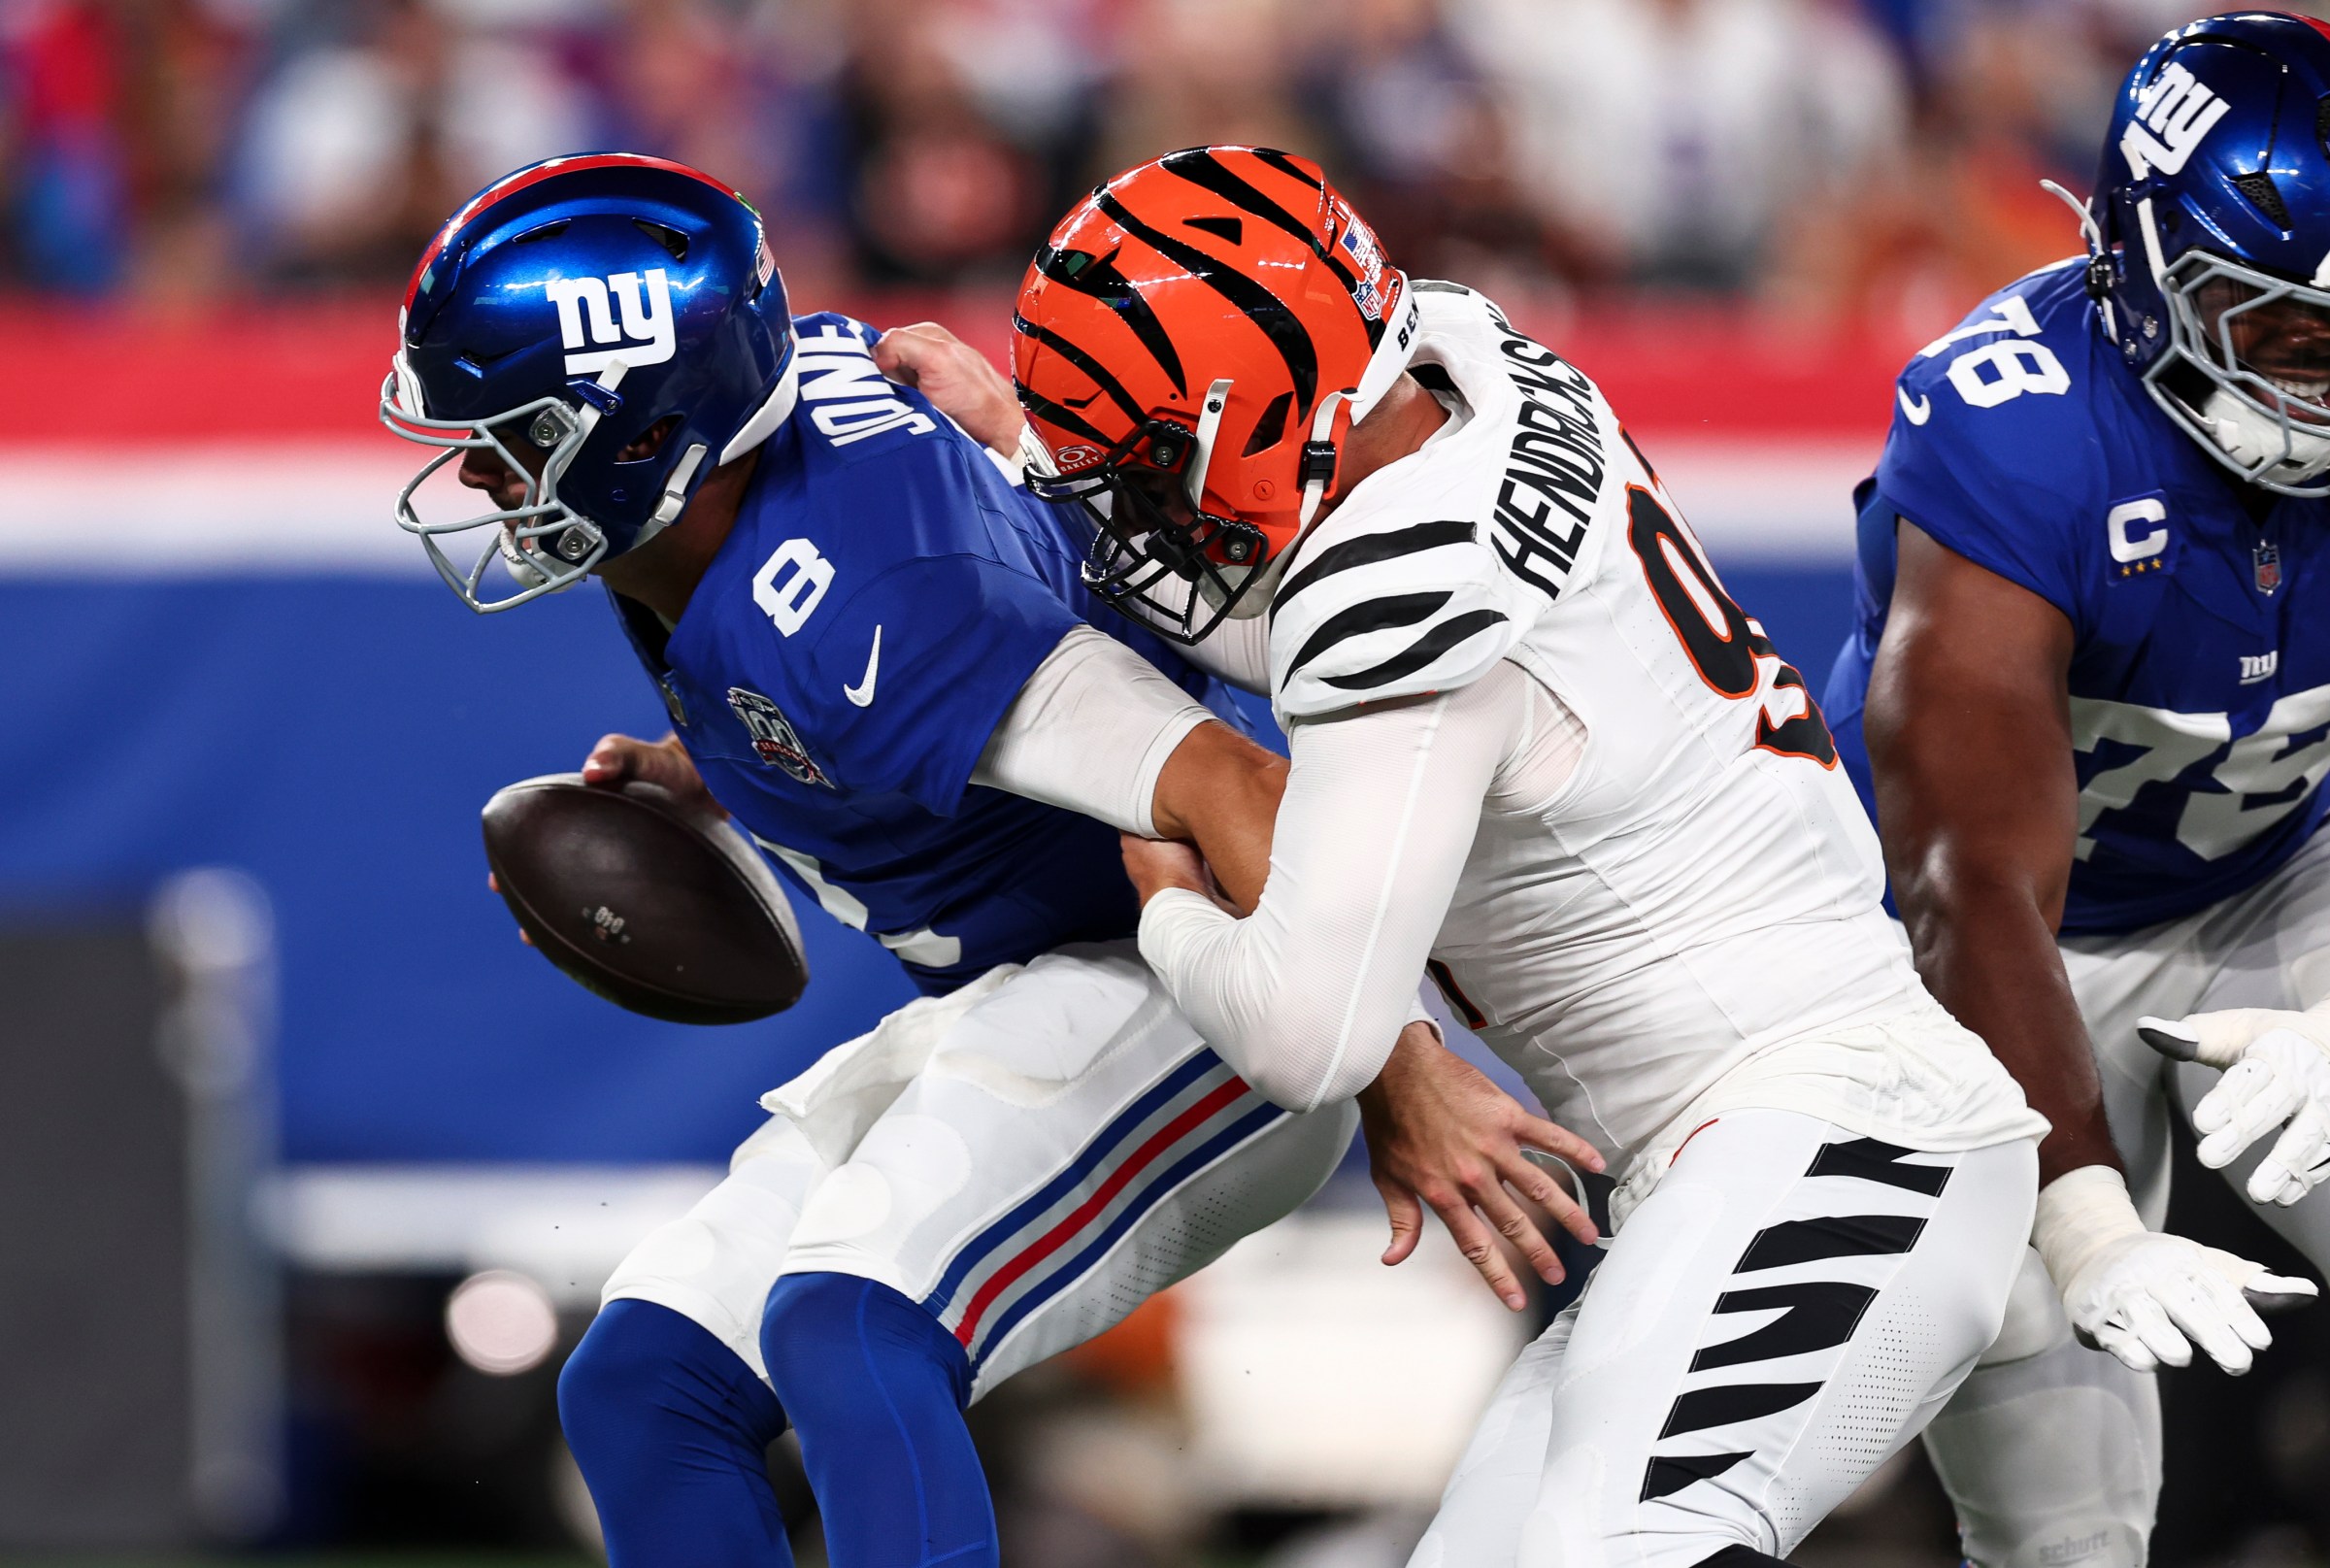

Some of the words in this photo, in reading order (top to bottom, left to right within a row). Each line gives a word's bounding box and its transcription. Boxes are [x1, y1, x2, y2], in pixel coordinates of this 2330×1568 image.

[1919, 295, 2071, 409] 78
[1060, 455, 1099, 472] OAKLEY
[1485, 302, 1607, 600] HENDRICKS
[2107, 497, 2168, 563] C
[752, 538, 836, 638] 8
